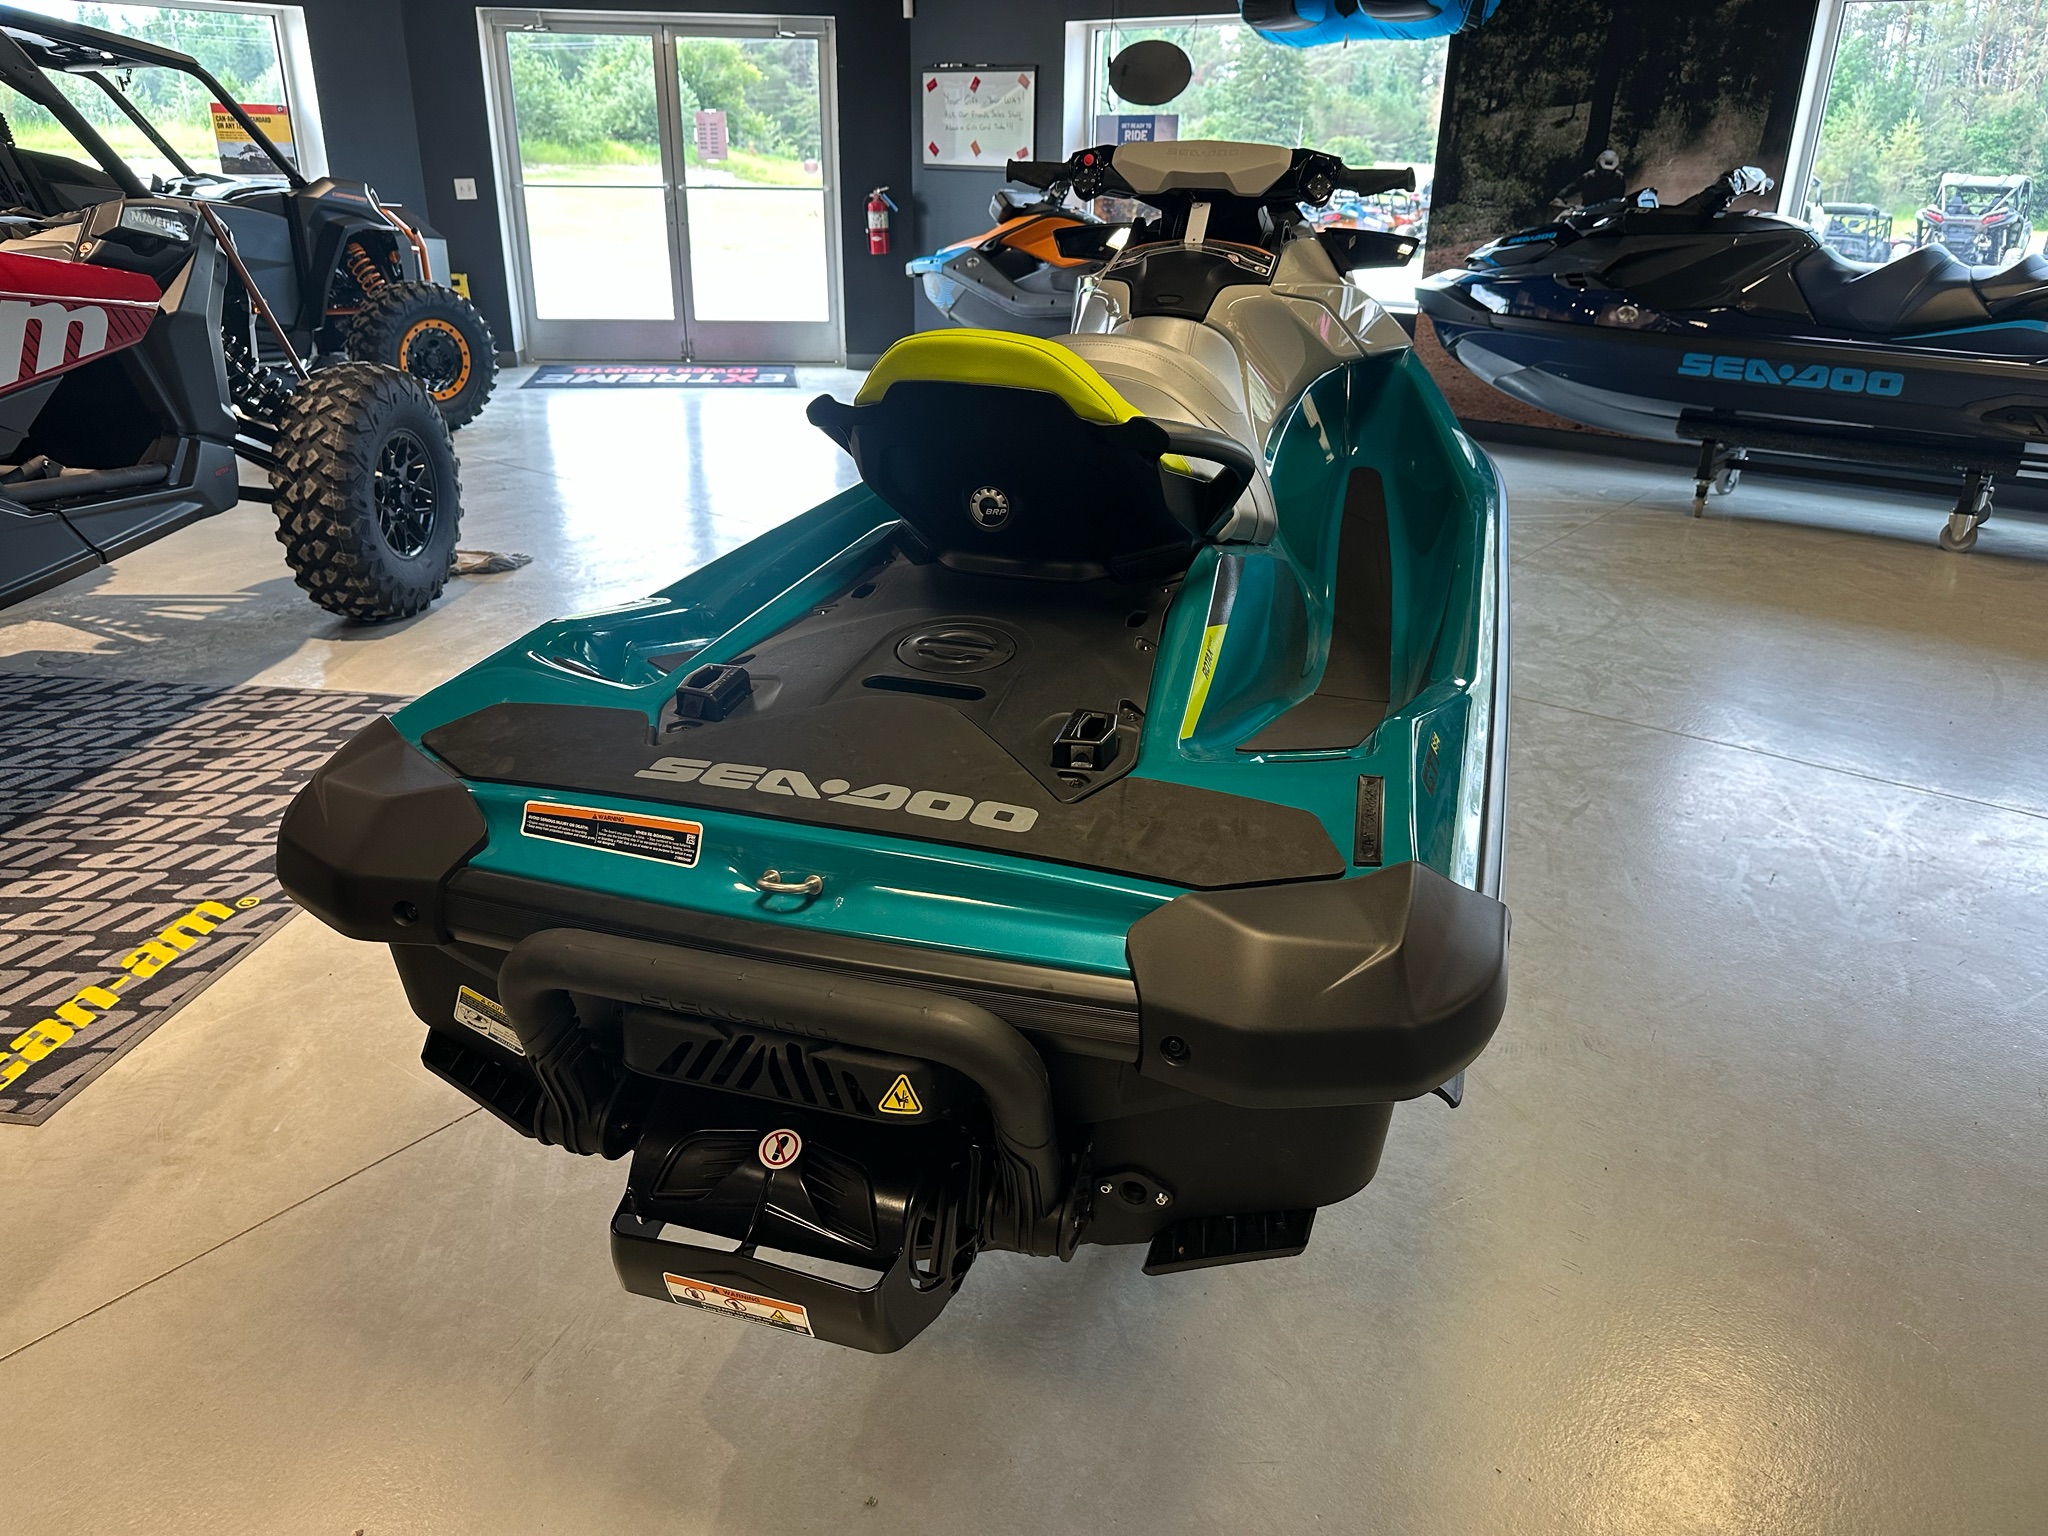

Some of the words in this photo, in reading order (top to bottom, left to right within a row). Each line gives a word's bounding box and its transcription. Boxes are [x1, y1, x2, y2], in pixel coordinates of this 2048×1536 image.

[1124, 130, 1148, 141] RIDE
[534, 373, 788, 384] EXTREME
[598, 814, 625, 823] WARNING
[722, 1289, 761, 1303] WARNING
